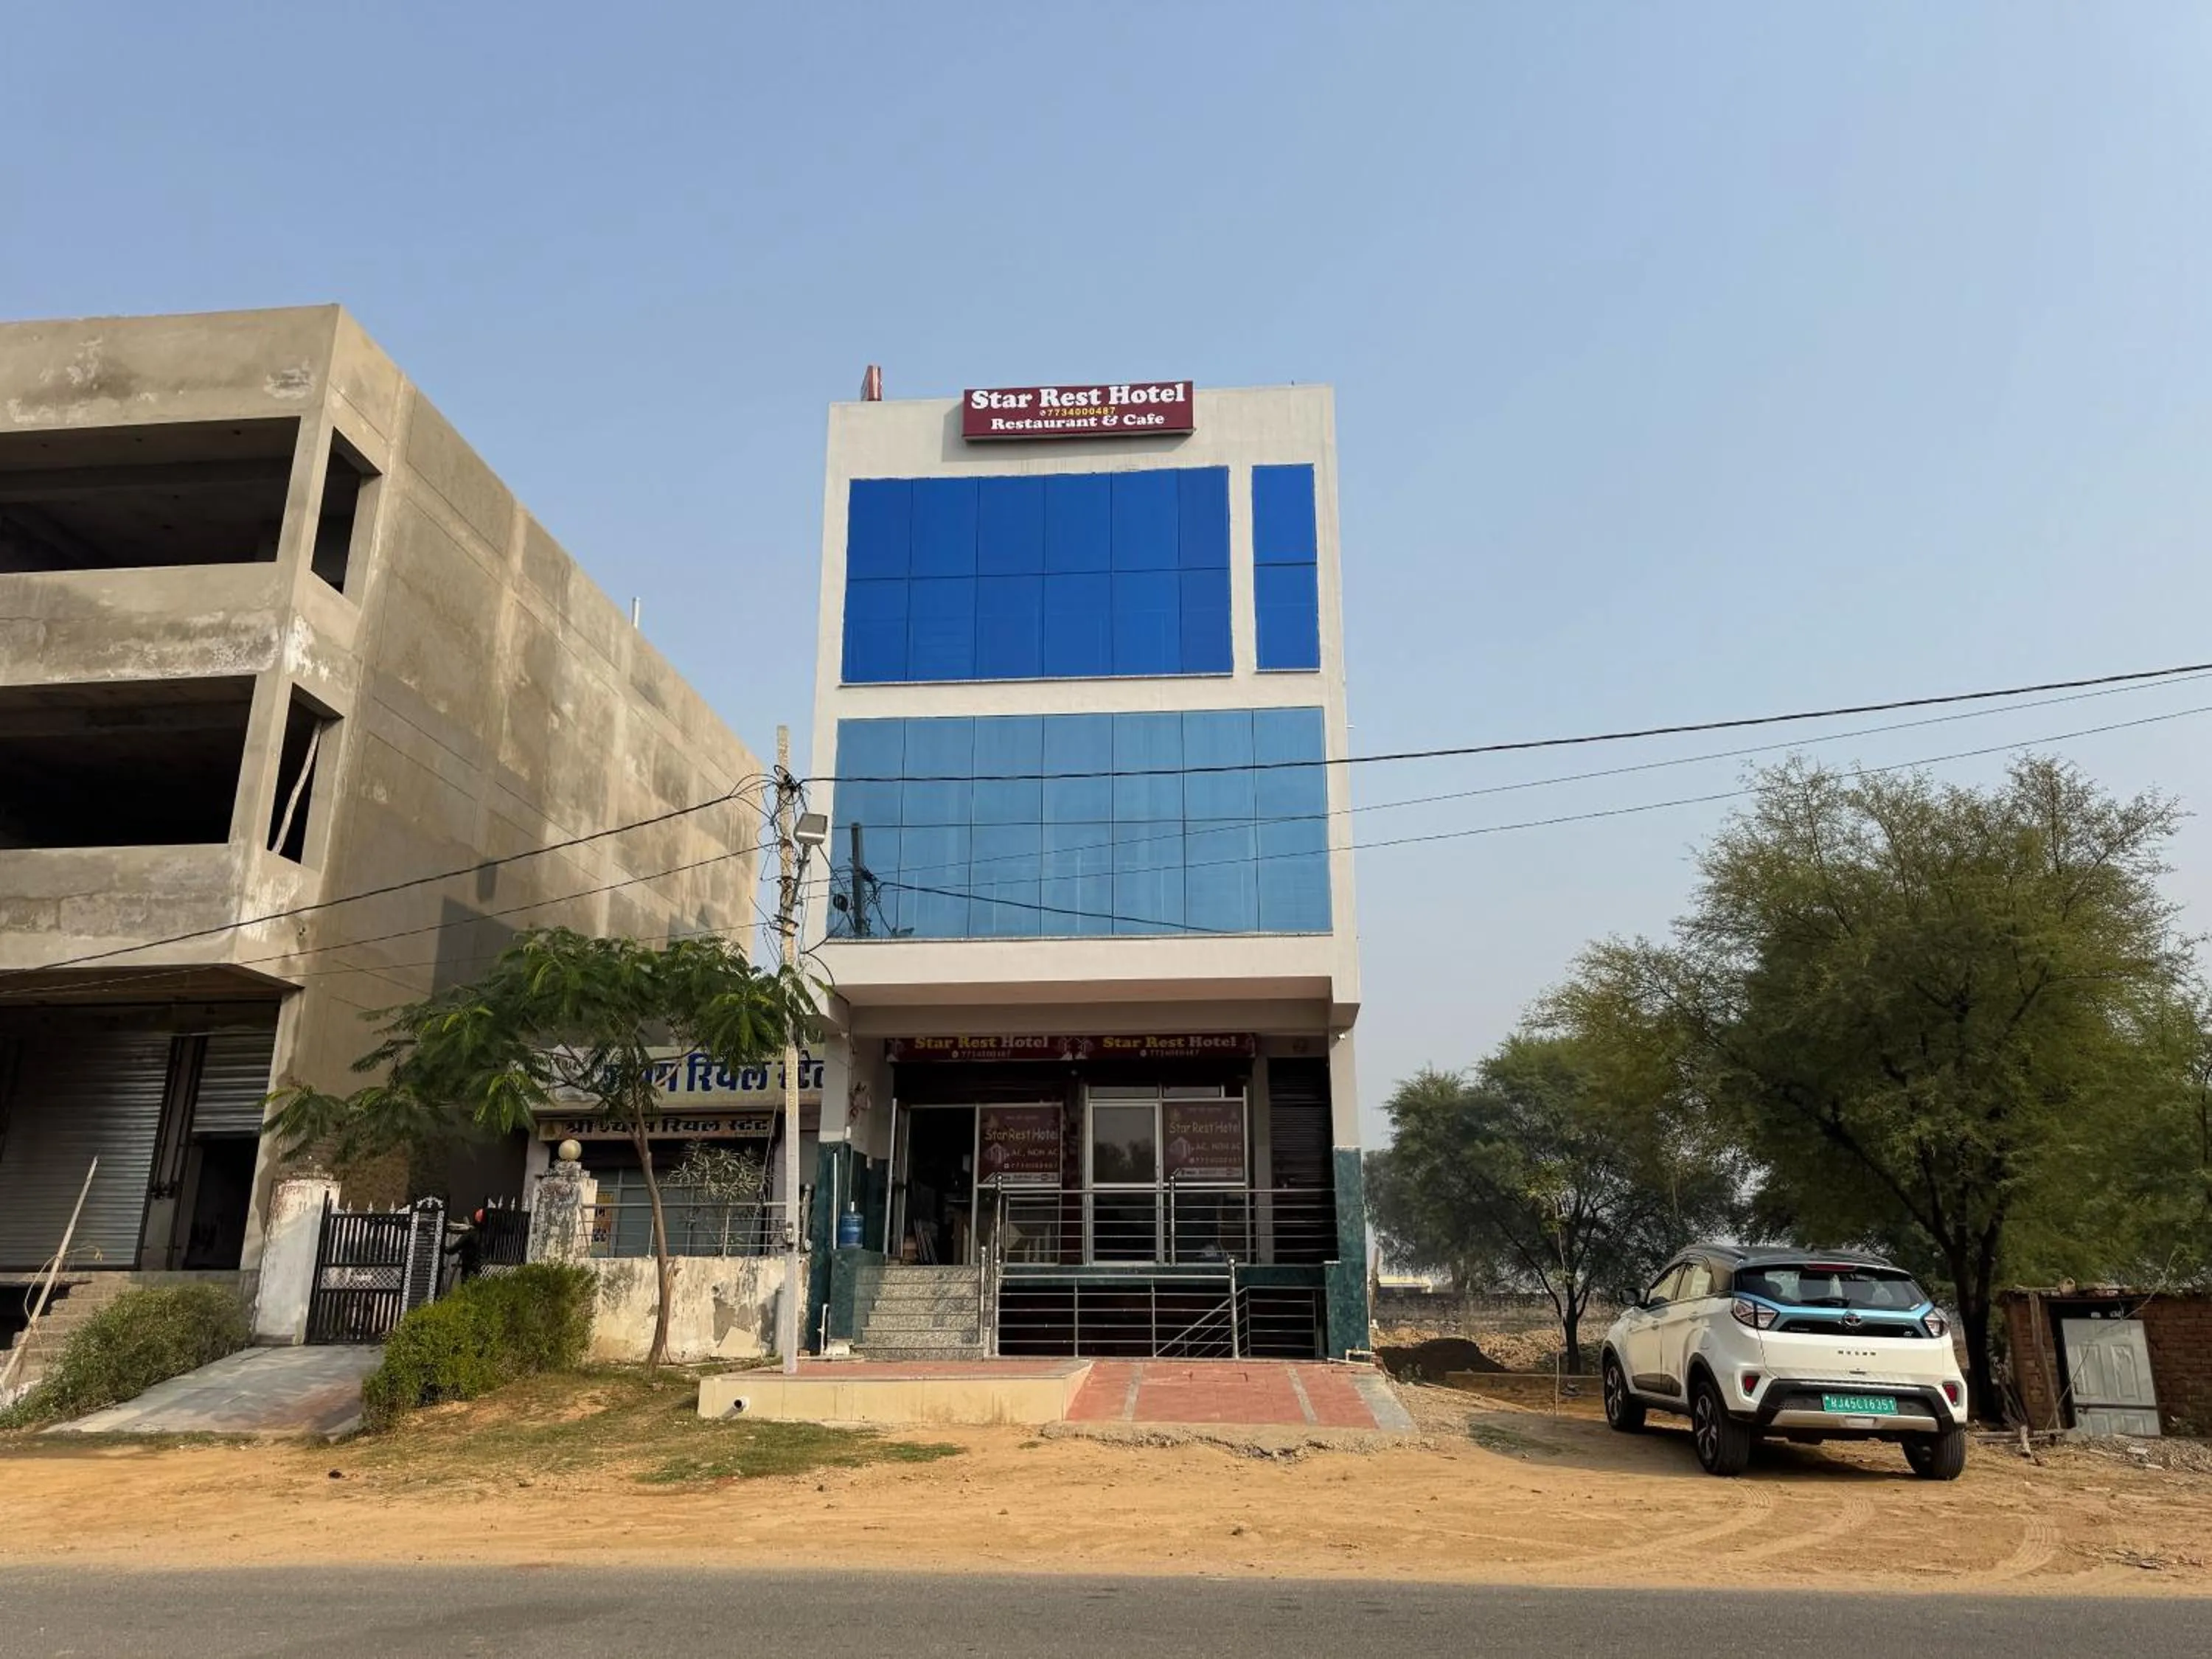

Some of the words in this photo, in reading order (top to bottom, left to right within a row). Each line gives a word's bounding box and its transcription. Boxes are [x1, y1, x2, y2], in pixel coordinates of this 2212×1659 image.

[971, 390, 1032, 408] Star
[1040, 387, 1102, 407] Rest
[1108, 383, 1185, 405] Hotel
[991, 417, 1097, 430] Restaurant
[1102, 414, 1118, 425] &
[1123, 414, 1164, 425] Cafe
[914, 1037, 953, 1048] Star
[959, 1036, 997, 1048] Rest
[1001, 1034, 1048, 1047] Hotel
[1102, 1037, 1141, 1048] Star
[1145, 1036, 1185, 1048] Rest
[1189, 1035, 1237, 1047] Hotel
